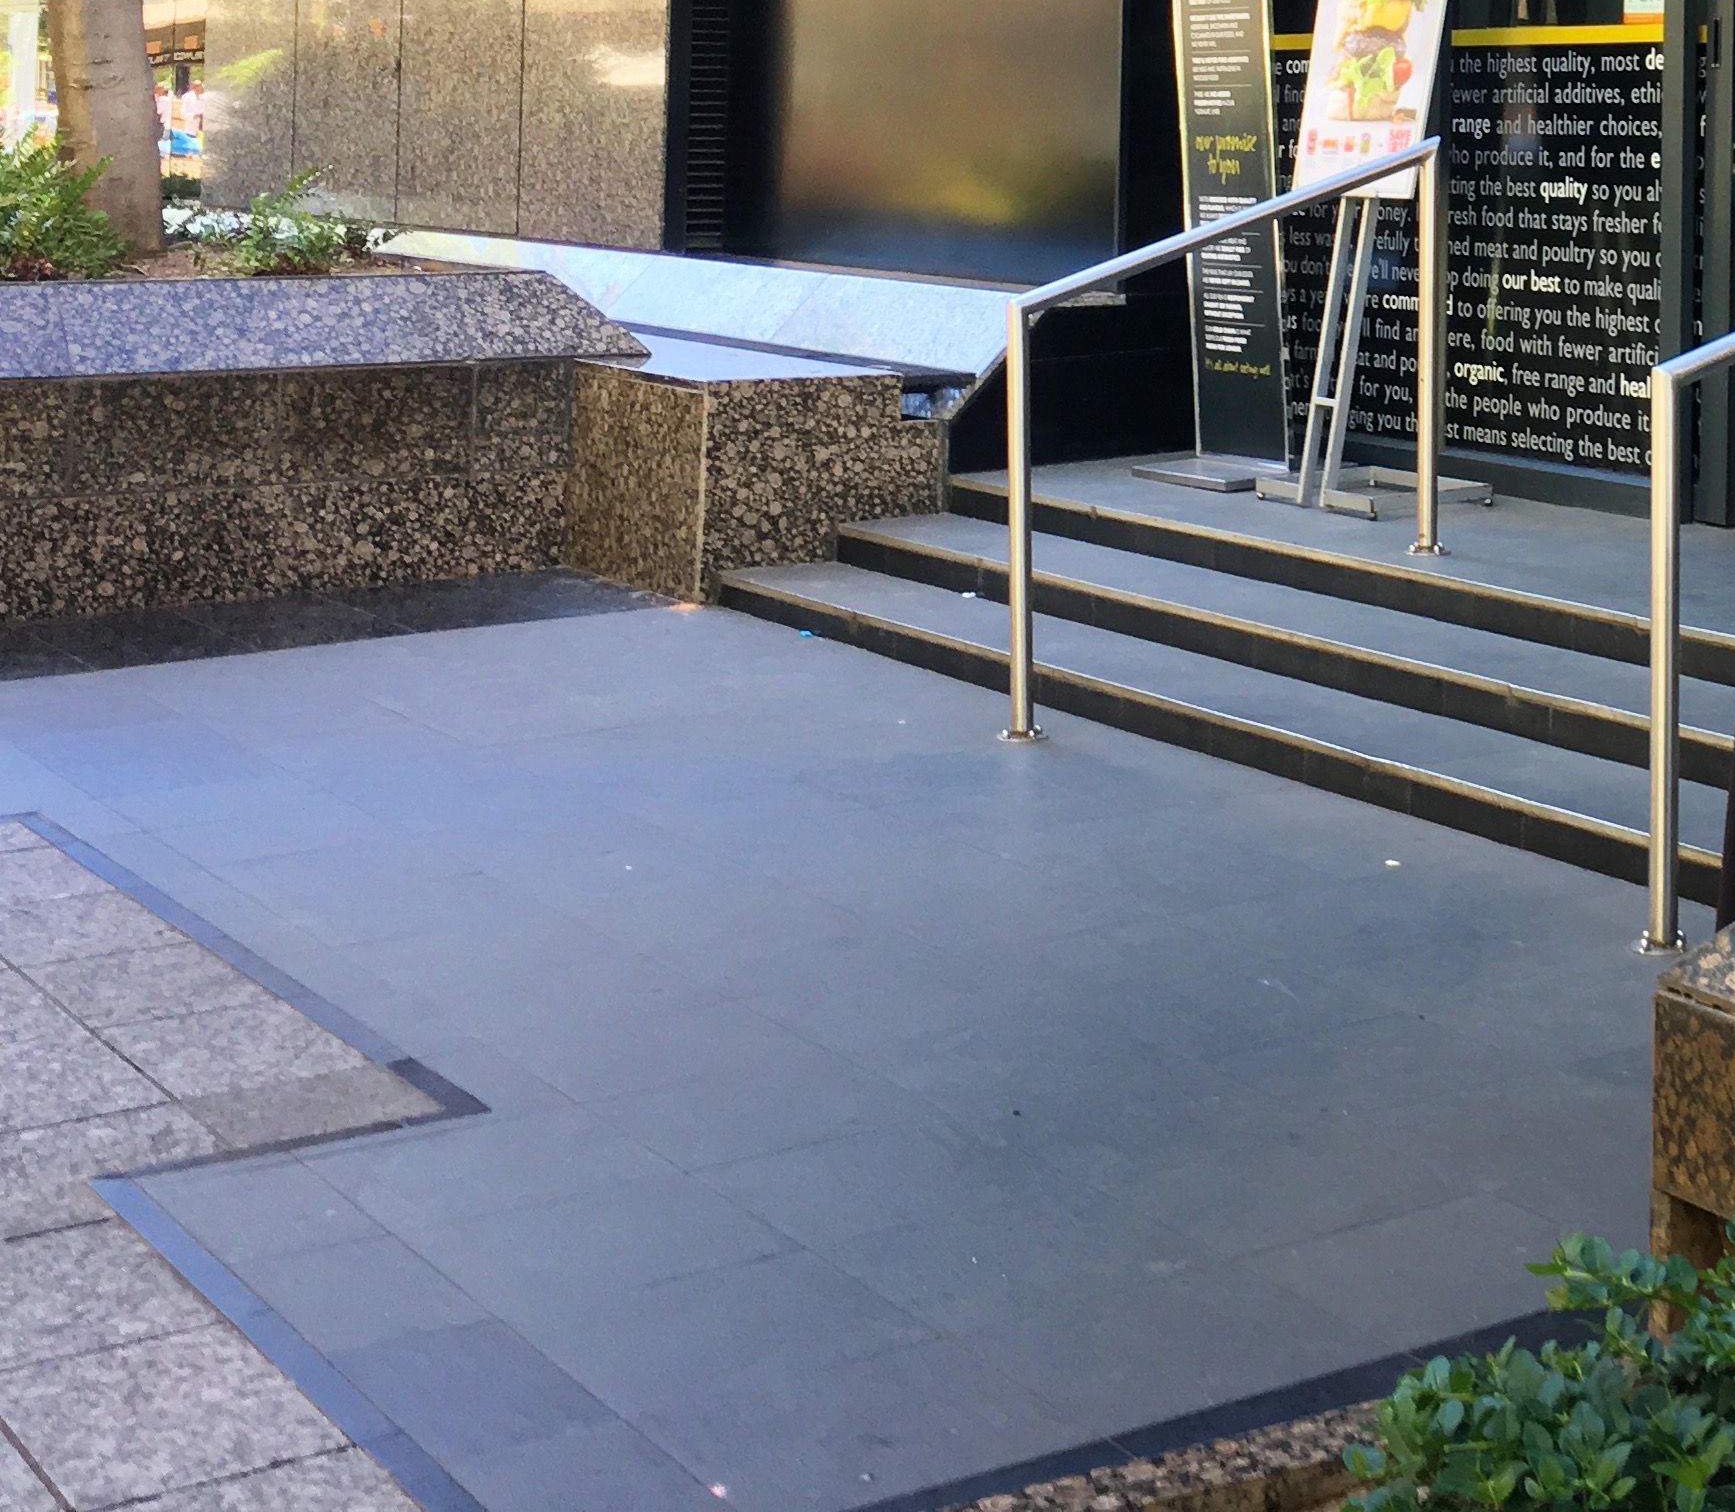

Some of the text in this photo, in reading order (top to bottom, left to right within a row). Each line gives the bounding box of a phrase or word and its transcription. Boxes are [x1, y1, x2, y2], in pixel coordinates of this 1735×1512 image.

[1460, 52, 1482, 74] the
[1487, 52, 1537, 79] highest
[1542, 50, 1596, 79] quality,
[1601, 53, 1640, 73] most
[1452, 82, 1626, 106] ewer artificial additives,
[1452, 112, 1663, 140] range and healthier choices,
[1475, 144, 1645, 171] produce it, and for the
[1480, 175, 1642, 208] the best quality so you
[1481, 204, 1648, 237] food that stays fresher
[1474, 241, 1509, 259] meat
[1512, 238, 1538, 261] and
[1542, 240, 1596, 271] poultry
[1599, 248, 1618, 266] so
[1622, 249, 1650, 273] you
[1462, 266, 1662, 306] doing our best to make quali
[1457, 298, 1650, 337] to offering you the highest
[1375, 317, 1660, 366] find food with fewer artifici
[1373, 349, 1616, 397] and organic, free range and
[1359, 375, 1632, 429] for you, the people who produce
[1377, 412, 1640, 464] you means selecting the best
